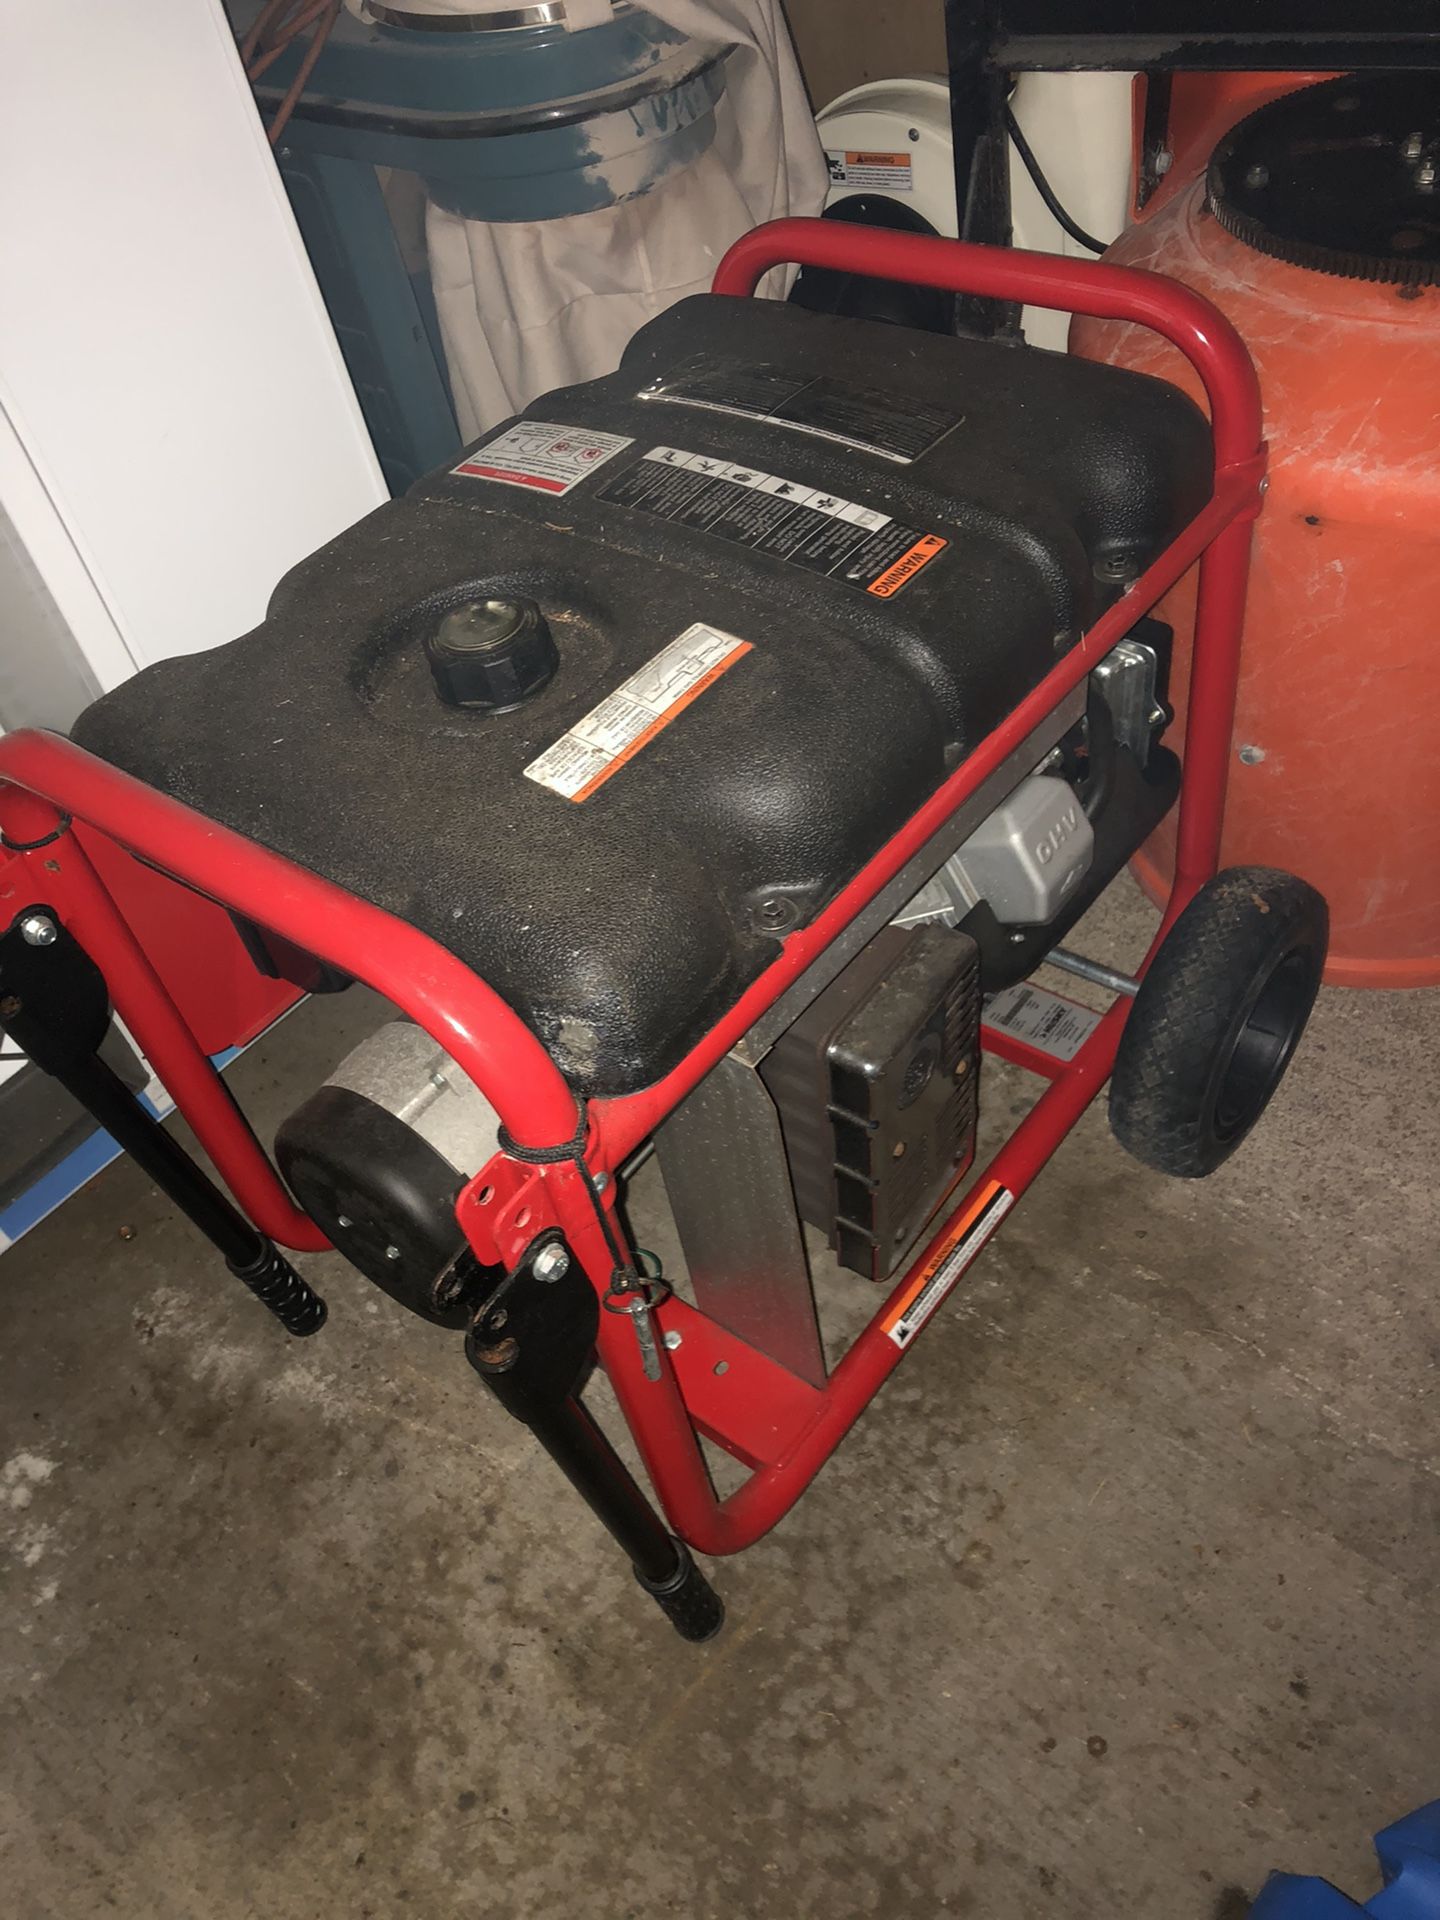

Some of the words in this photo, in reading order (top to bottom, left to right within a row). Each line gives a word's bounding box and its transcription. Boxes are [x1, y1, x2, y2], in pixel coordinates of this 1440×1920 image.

[874, 552, 927, 594] WARNING
[1036, 807, 1078, 864] OHV
[929, 1237, 957, 1270] WARNING
